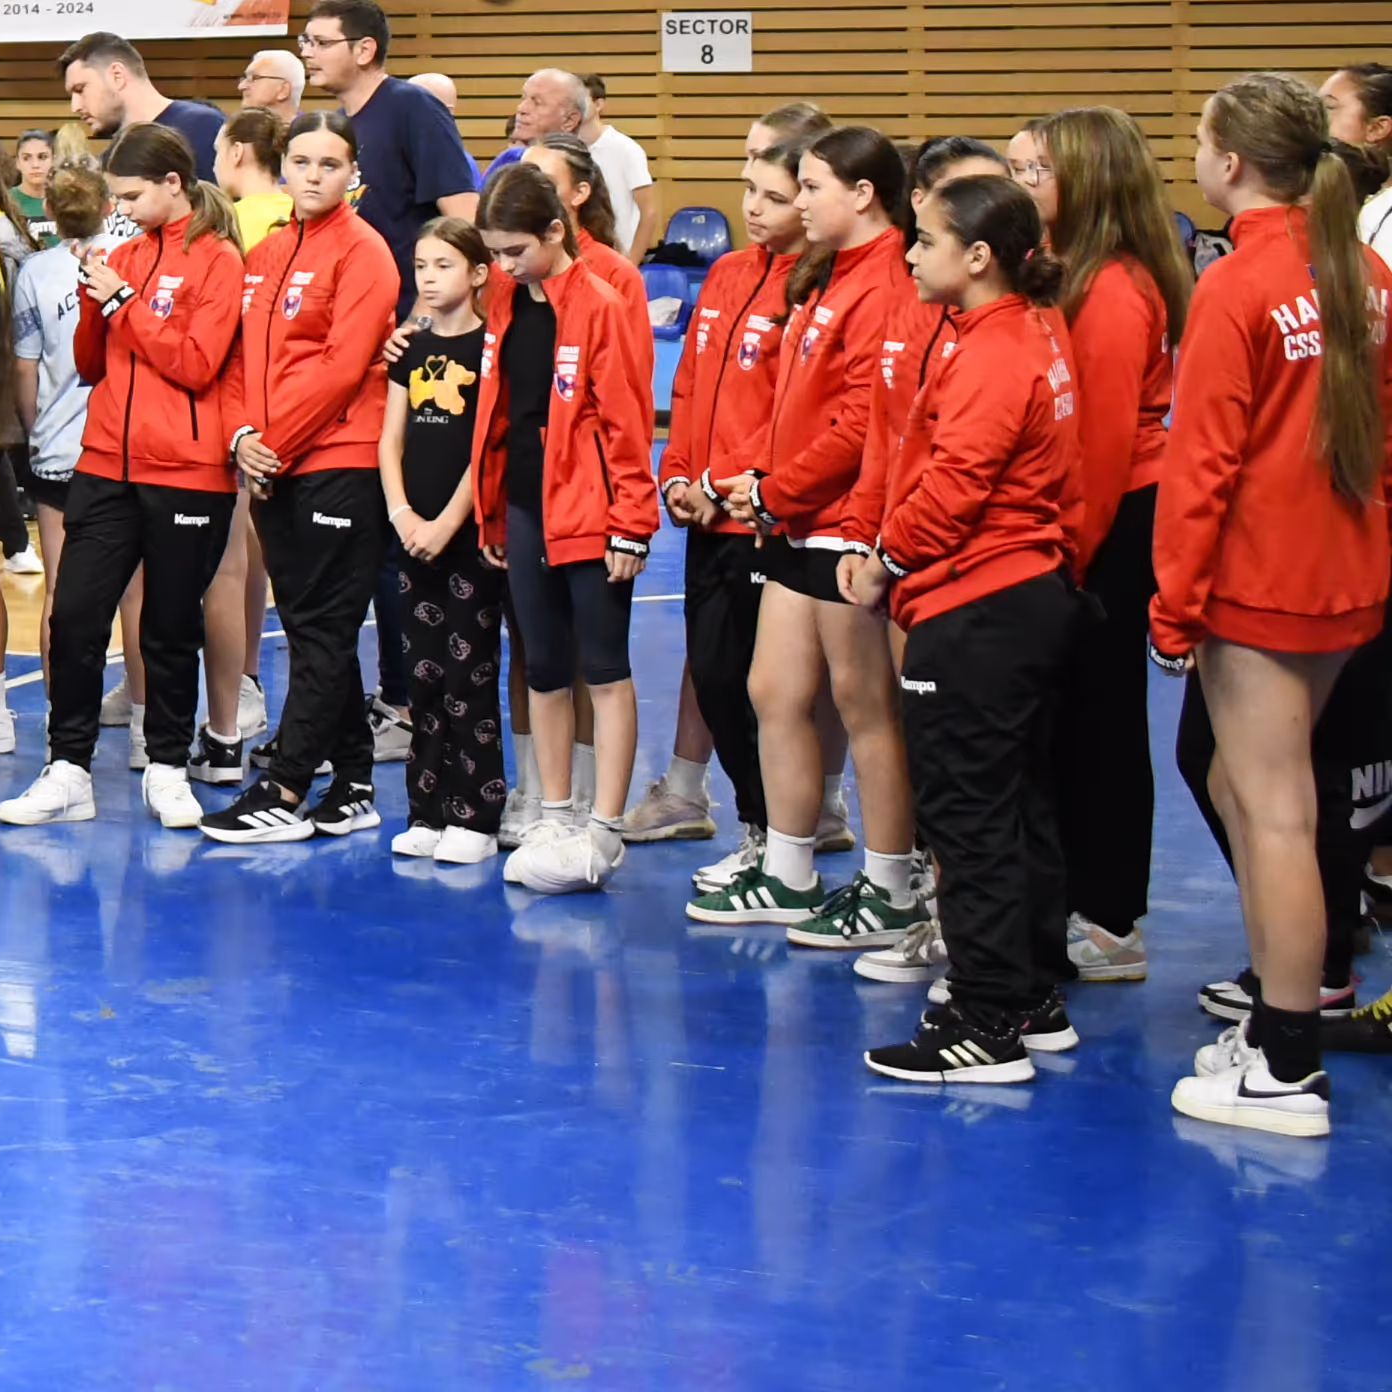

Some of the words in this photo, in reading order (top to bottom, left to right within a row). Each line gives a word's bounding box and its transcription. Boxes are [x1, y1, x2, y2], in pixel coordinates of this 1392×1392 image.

[3, 2, 41, 16] 2014
[56, 1, 95, 16] 2024
[666, 19, 749, 35] SECTOR
[701, 44, 714, 65] 8
[174, 513, 210, 528] Kempa
[313, 512, 351, 528] Kempa
[611, 535, 648, 554] Kempa
